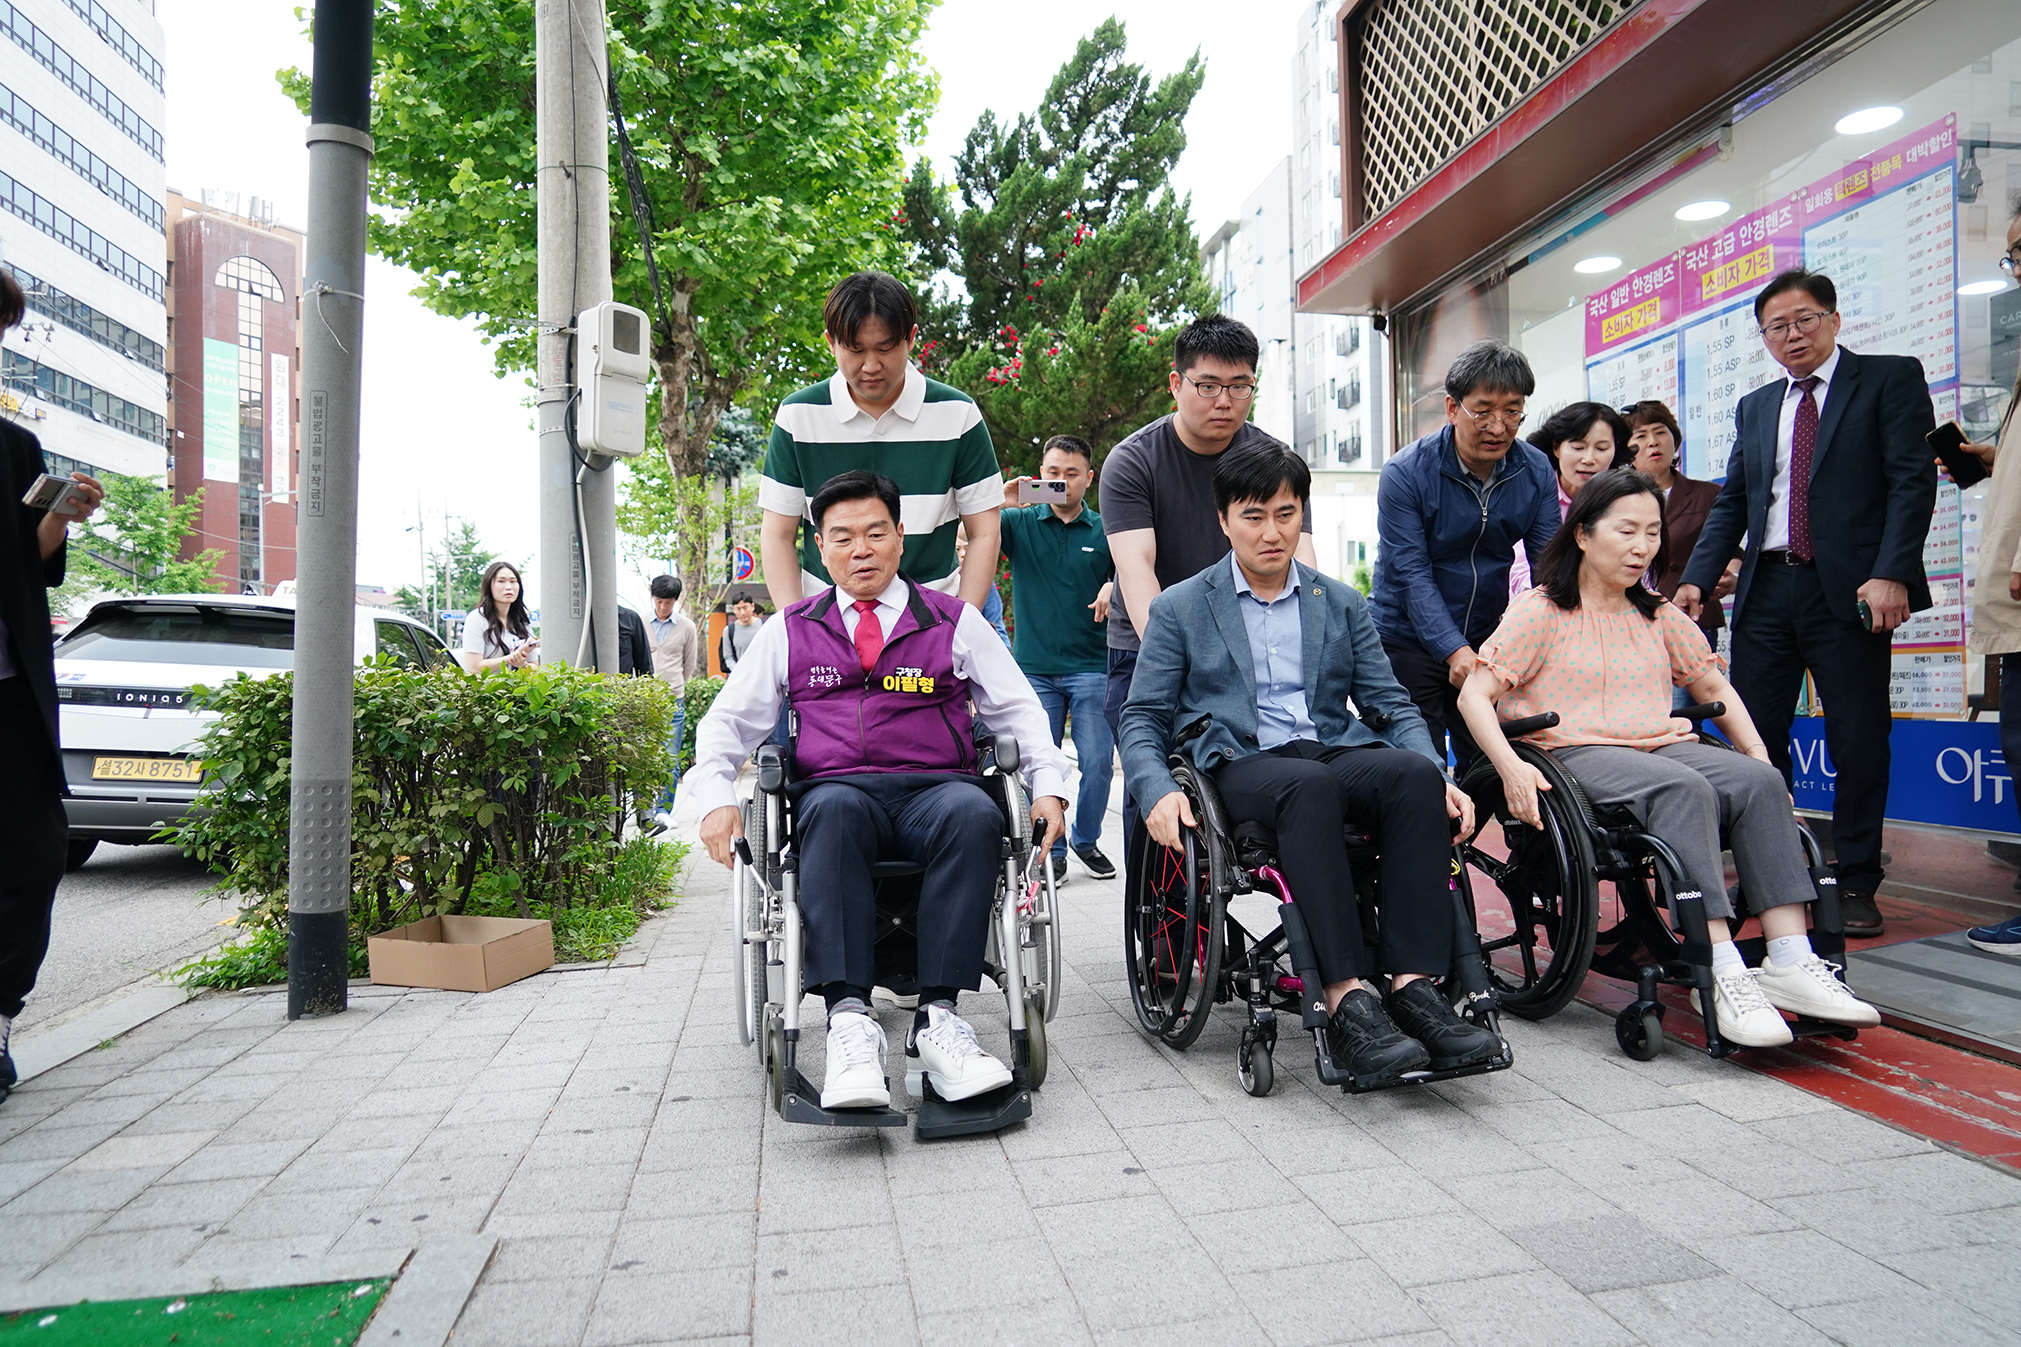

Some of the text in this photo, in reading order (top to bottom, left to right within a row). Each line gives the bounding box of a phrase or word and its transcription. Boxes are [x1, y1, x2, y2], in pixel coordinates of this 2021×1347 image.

[1804, 188, 1834, 214] 일회용
[1870, 154, 1902, 182] 전품목
[1906, 128, 1952, 163] 대박할인
[1686, 206, 1793, 271] 국산 고급 안경렌즈
[1705, 262, 1740, 296] 소비자
[1745, 248, 1770, 276] 가격
[1590, 263, 1674, 318] 국산 일반 안경렌즈
[1604, 300, 1658, 339] 소비자 가격
[1706, 340, 1722, 355] 1.55
[1724, 334, 1736, 349] SP
[1707, 364, 1723, 379] 1.55
[1724, 356, 1741, 372] ASP
[204, 373, 238, 388] OPEN
[1707, 387, 1723, 402] 1.60
[1724, 382, 1736, 398] SP
[1707, 408, 1736, 426] 1.60 AS
[1707, 431, 1737, 450] 1.67 AS
[311, 396, 322, 512] 불법광고물 부착금지
[1708, 458, 1724, 473] 1.74
[572, 582, 580, 616] 부착금지
[808, 674, 842, 687] 동대문구
[896, 667, 923, 677] 구청장
[883, 676, 934, 693] 이필형
[149, 761, 193, 778] 8751
